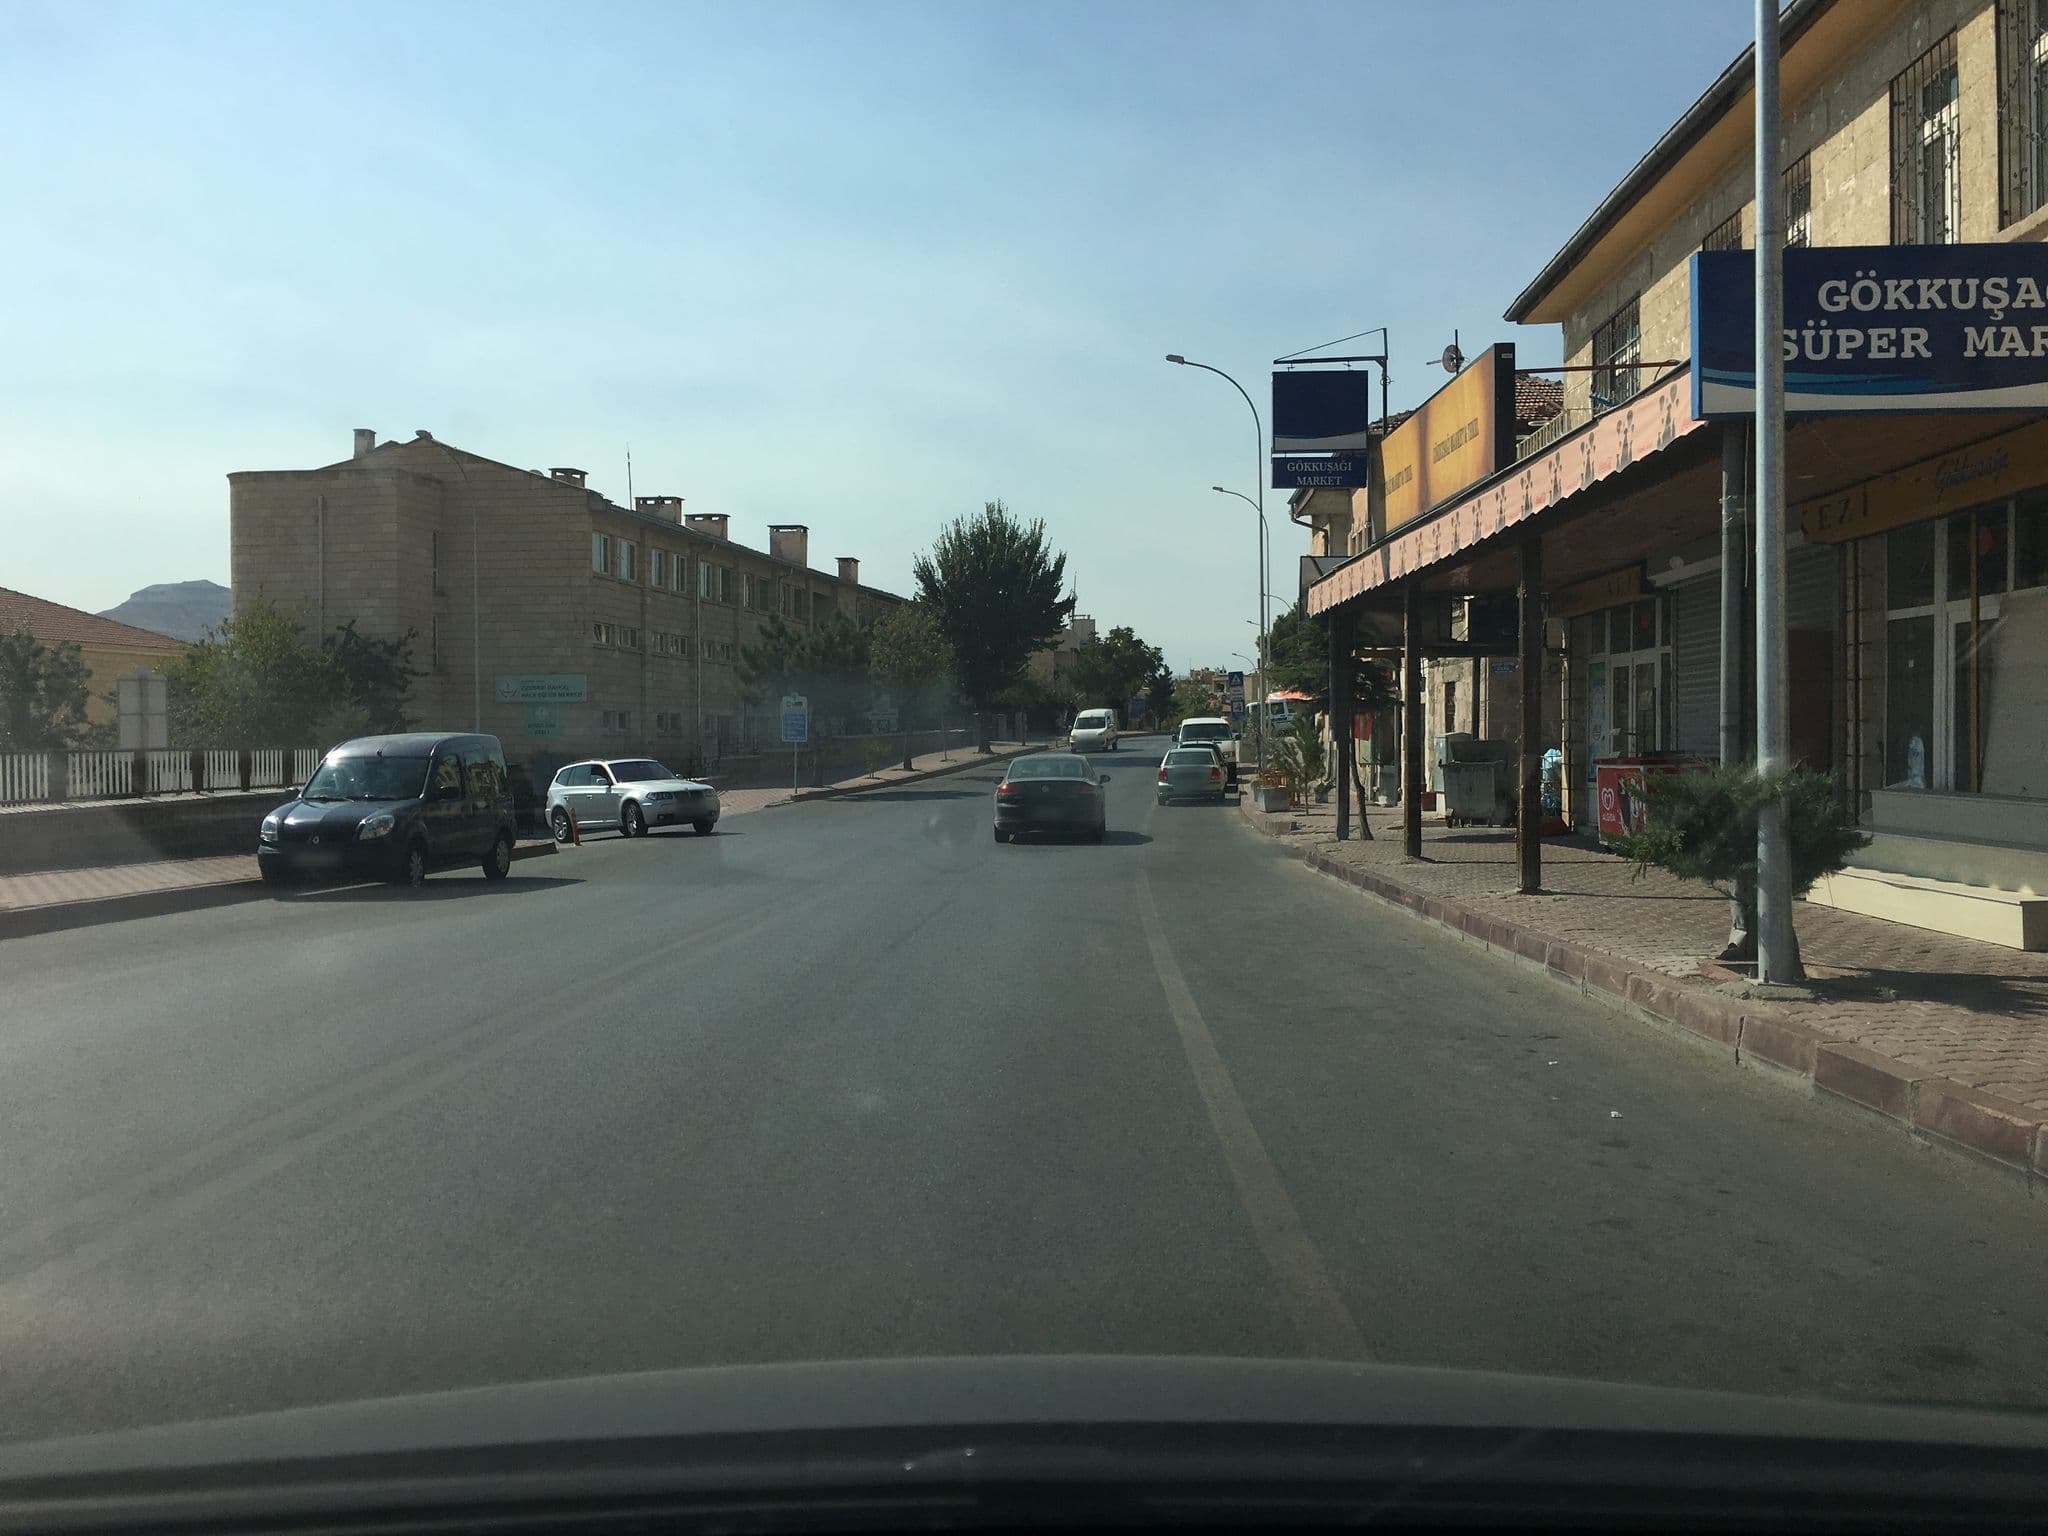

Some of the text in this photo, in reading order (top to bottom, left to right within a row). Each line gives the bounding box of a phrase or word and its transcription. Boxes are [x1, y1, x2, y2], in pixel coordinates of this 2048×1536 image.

[1817, 269, 2048, 321] GÖKKUŞA
[1783, 319, 1932, 361] SÜPER
[1287, 460, 1353, 474] GÖKKUŞAĞI
[1296, 475, 1342, 486] MARKET
